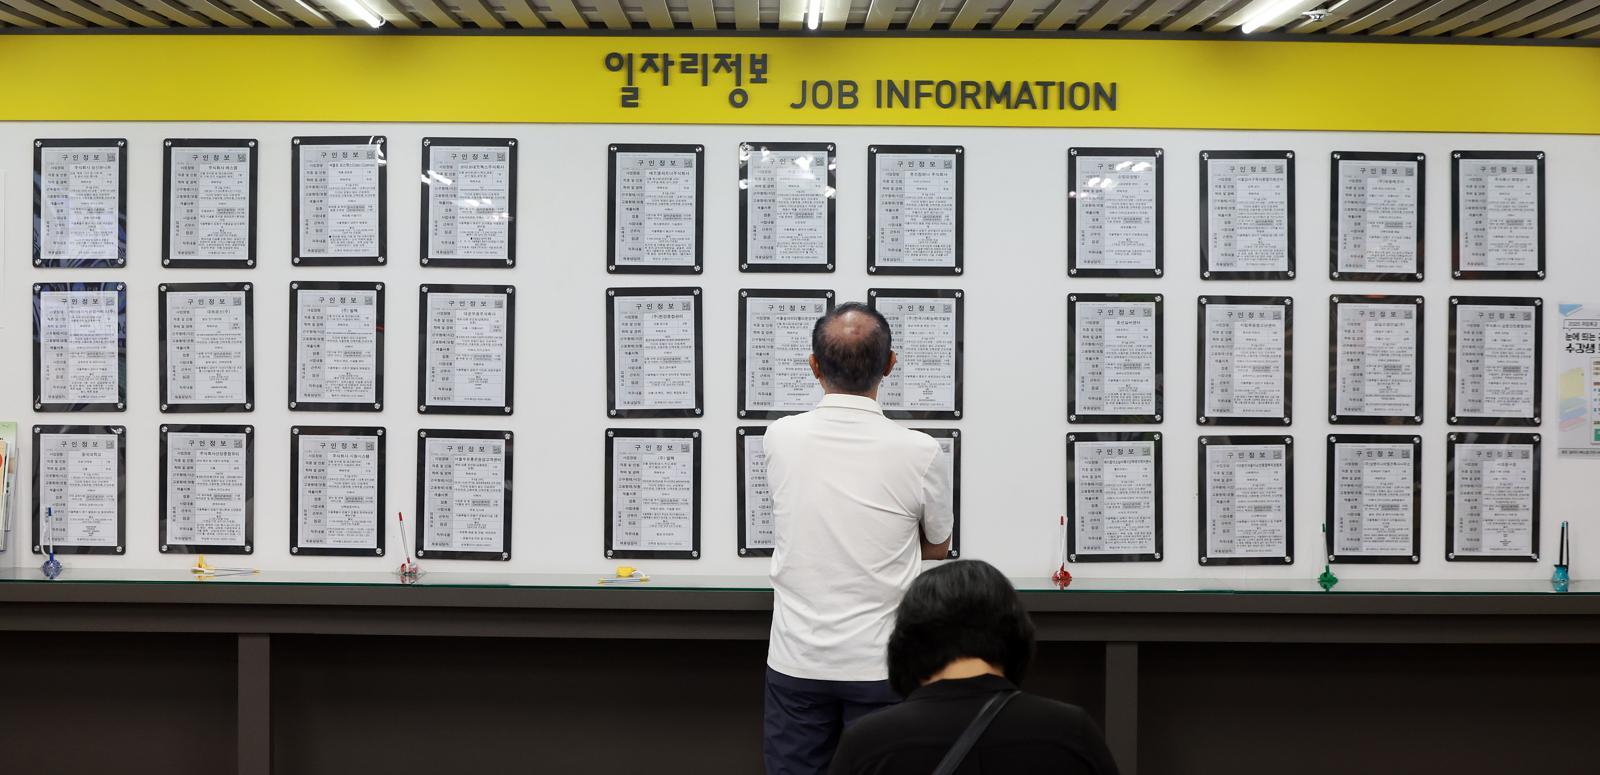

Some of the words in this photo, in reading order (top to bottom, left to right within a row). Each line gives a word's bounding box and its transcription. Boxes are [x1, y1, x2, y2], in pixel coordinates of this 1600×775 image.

[604, 52, 768, 109] 일자리정보
[790, 79, 859, 110] JOB
[876, 79, 1117, 111] INFORMATION
[1565, 343, 1595, 353] 수강생
